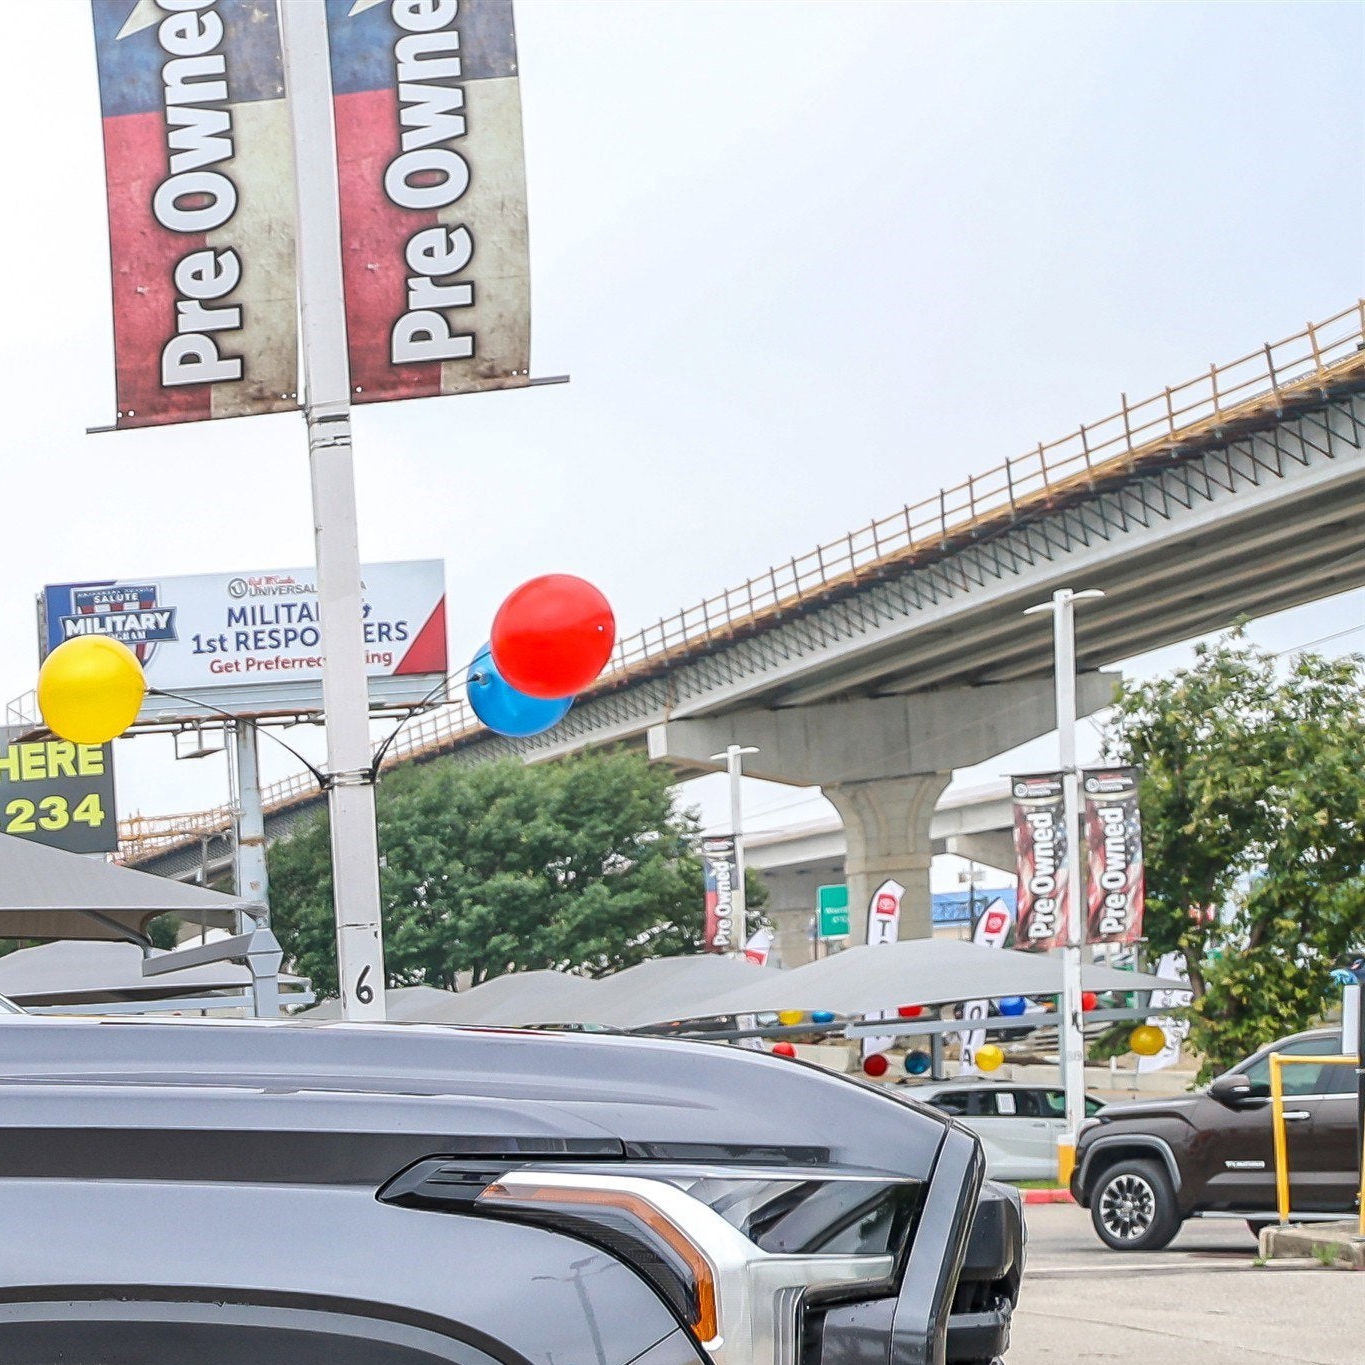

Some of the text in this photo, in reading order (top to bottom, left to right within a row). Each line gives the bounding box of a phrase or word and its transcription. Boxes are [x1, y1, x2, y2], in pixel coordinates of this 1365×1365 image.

[152, 0, 243, 388] Pre Owne
[390, 225, 474, 366] Pre
[93, 592, 139, 604] SALUTE
[227, 601, 320, 628] MILITA
[65, 611, 170, 636] MILITARY
[192, 620, 408, 654] 1st RESPOERS
[210, 659, 241, 675] Get
[1026, 811, 1056, 896] Owned
[1097, 806, 1127, 891] Owned
[1028, 897, 1055, 939] Pre
[1100, 892, 1126, 934] Pre
[356, 964, 374, 1005] 6
